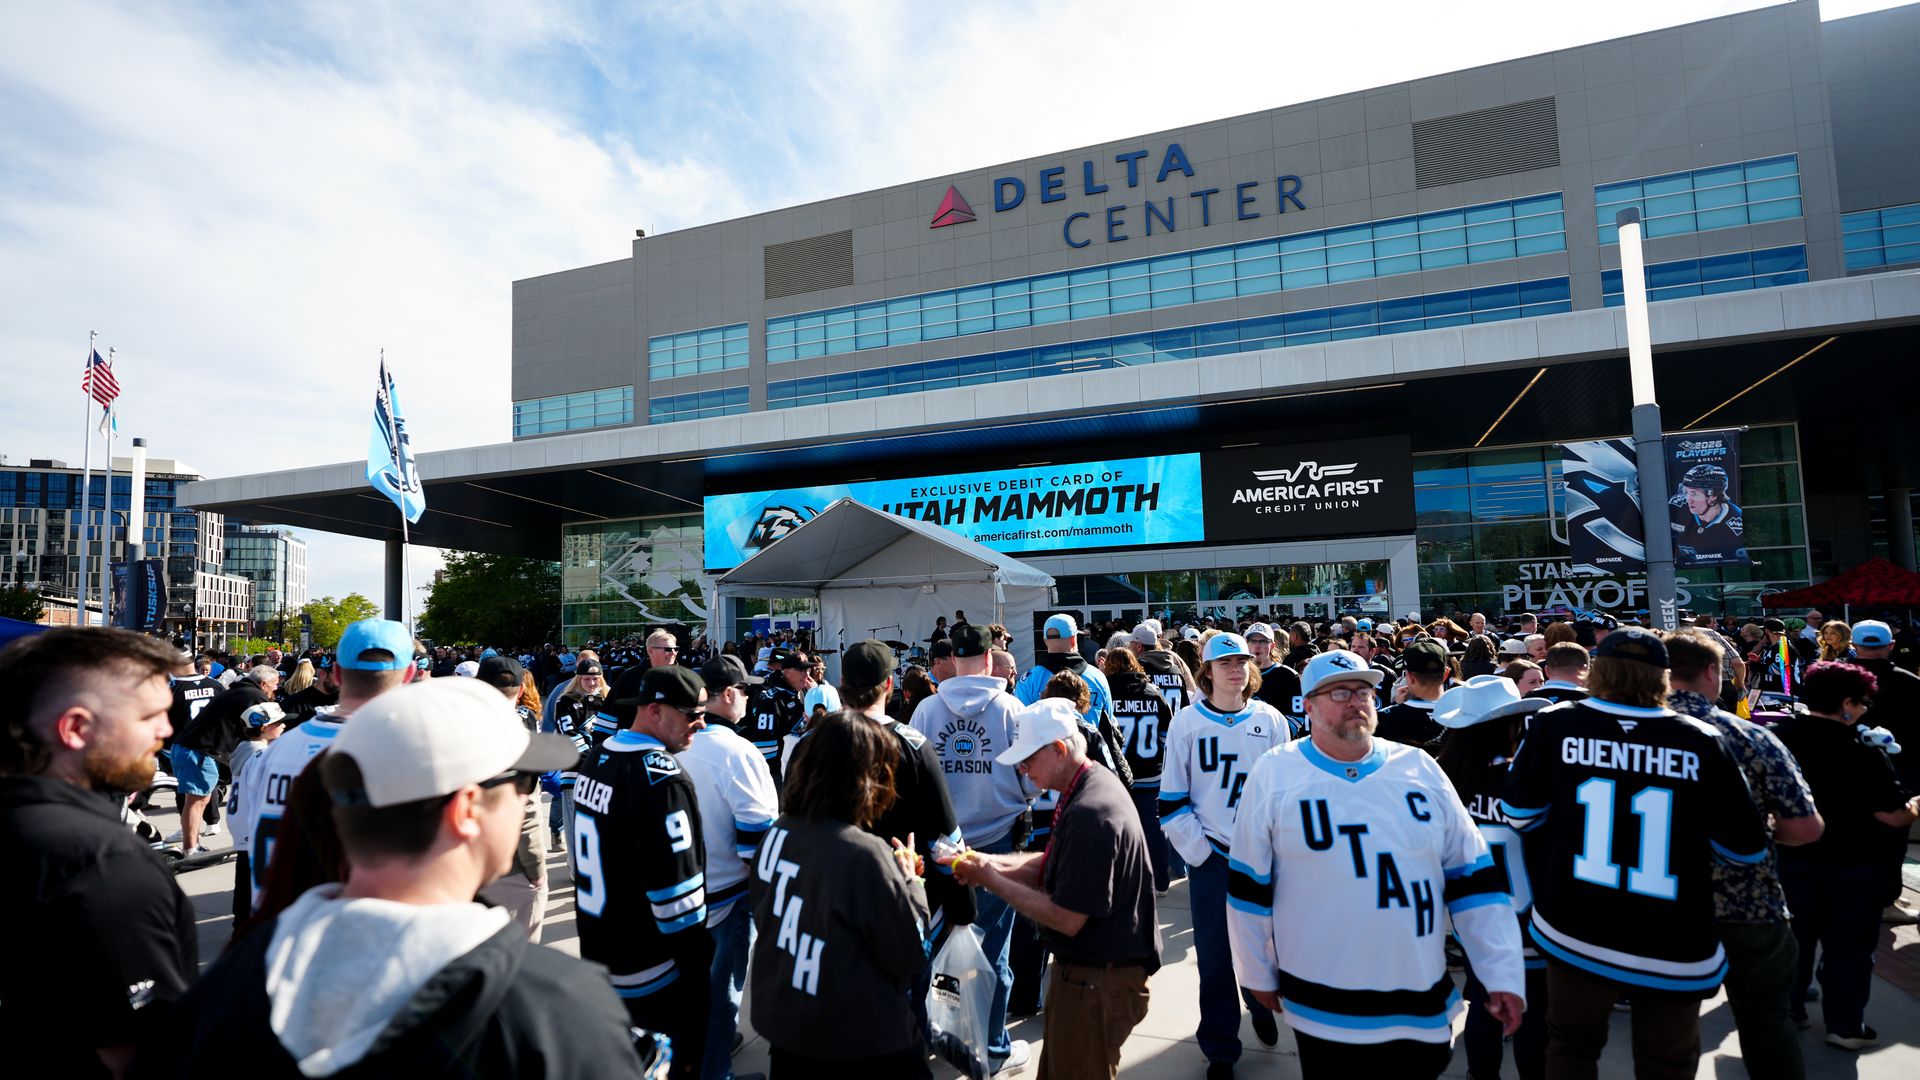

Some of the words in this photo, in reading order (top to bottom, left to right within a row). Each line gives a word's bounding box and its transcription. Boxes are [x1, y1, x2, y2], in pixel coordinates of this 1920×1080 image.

[993, 143, 1195, 212] DELTA
[1063, 174, 1306, 248] CENTER
[1675, 447, 1727, 459] PLAYOFFS
[1695, 440, 1723, 450] 2026
[910, 481, 992, 498] EXCLUSIVE
[998, 478, 1044, 491] DEBIT
[1050, 473, 1095, 488] CARD
[1101, 471, 1123, 483] OF
[1232, 484, 1321, 504] AMERICA
[1323, 478, 1384, 498] FIRST
[972, 482, 1161, 524] MAMMOTH
[1255, 503, 1306, 514] CREDIT
[1315, 500, 1360, 510] UNION
[974, 523, 1133, 543] americafirst.com/mammoth
[1518, 562, 1573, 580] STAN
[1502, 577, 1692, 611] PLAYOFS
[1659, 597, 1676, 632] GEEK
[184, 687, 215, 700] KELLER
[557, 714, 574, 735] 12
[757, 713, 774, 730] 81
[935, 719, 992, 756] INAUGURAL
[1116, 714, 1159, 759] 70
[647, 755, 676, 769] UTAH
[955, 741, 973, 751] UTAH
[1562, 736, 1700, 782] GUENTHER
[1198, 735, 1249, 808] UTA
[266, 773, 292, 805] CO
[1405, 791, 1432, 822] C
[665, 809, 692, 853] 9
[1573, 776, 1679, 901] 11
[574, 810, 607, 918] 9
[1298, 798, 1435, 938] UTAH
[757, 826, 826, 997] UTAH
